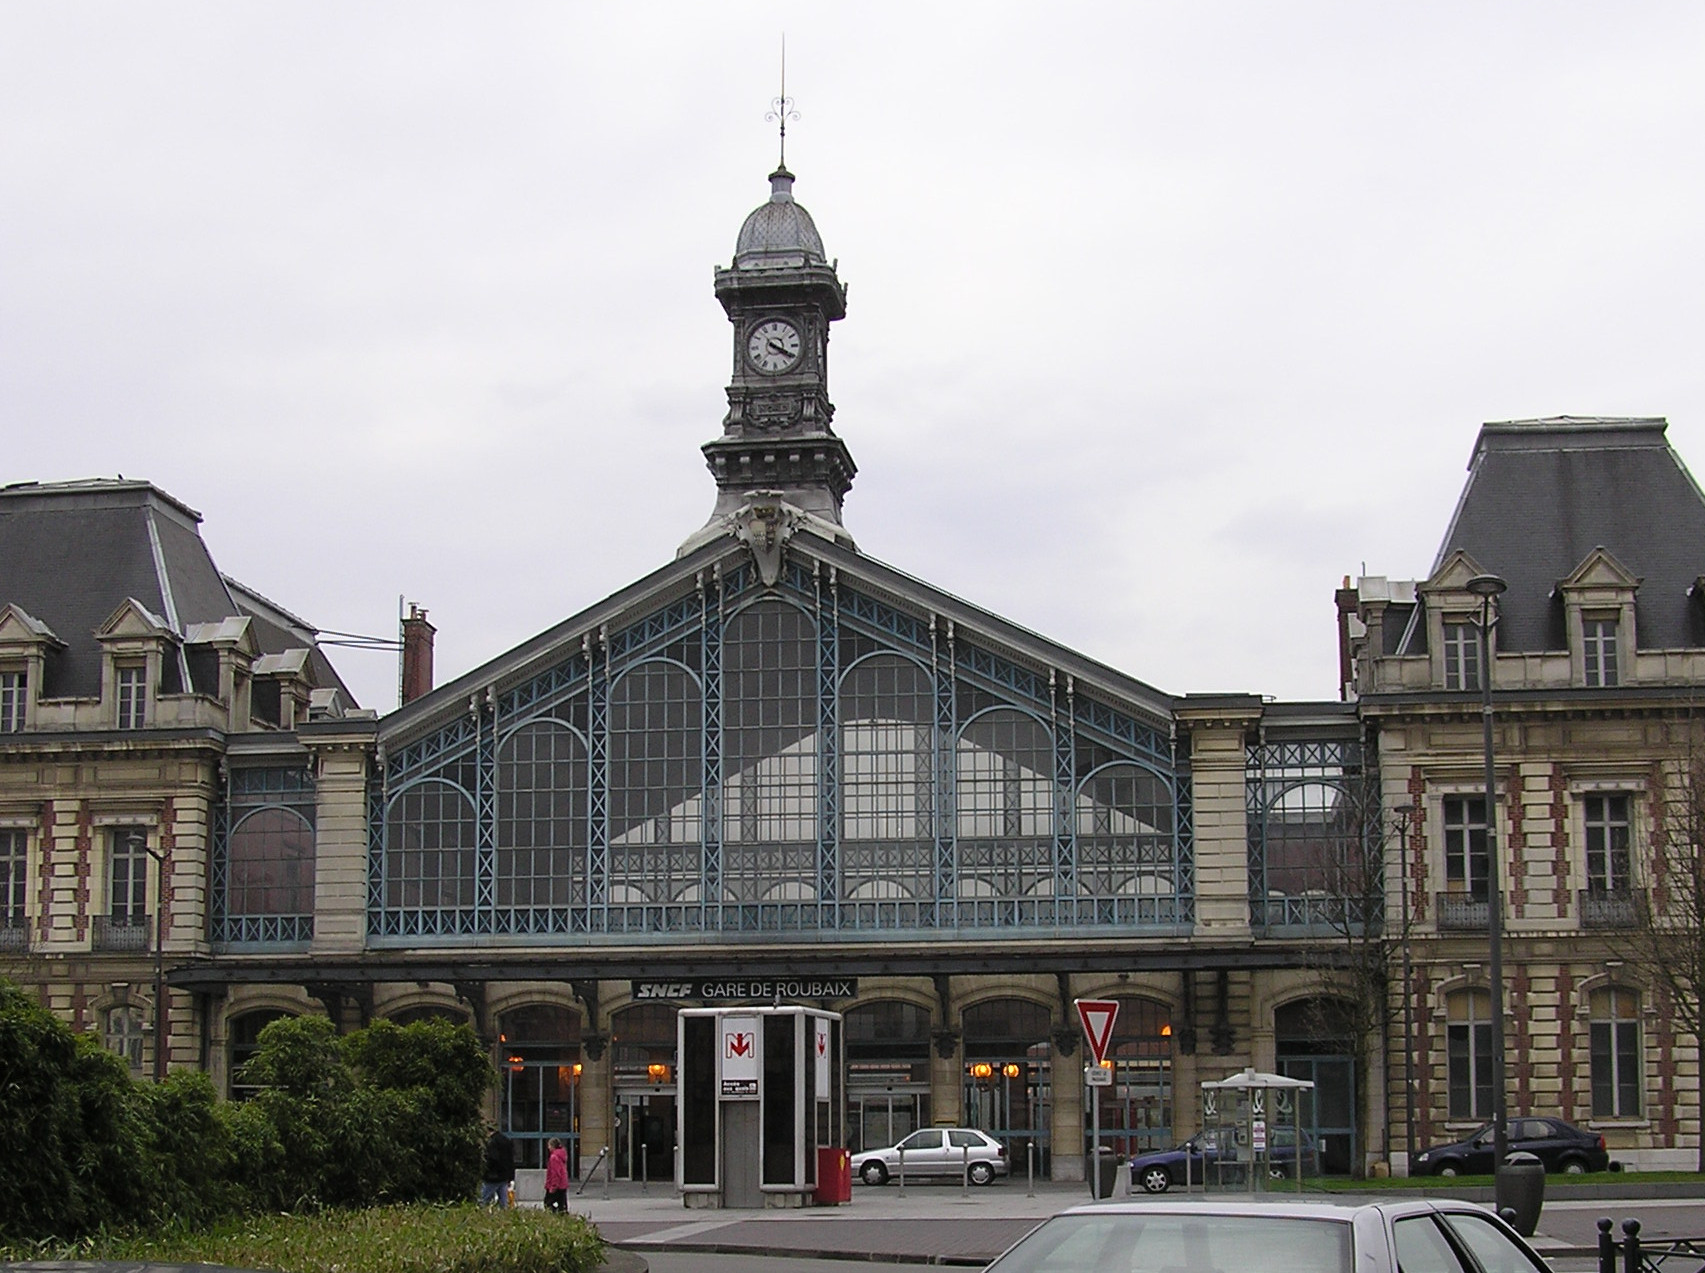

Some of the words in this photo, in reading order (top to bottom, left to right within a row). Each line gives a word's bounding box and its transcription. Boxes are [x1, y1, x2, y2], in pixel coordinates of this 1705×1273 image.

[637, 983, 693, 998] SNCF
[701, 982, 746, 998] GARE
[750, 982, 772, 997] DE
[776, 982, 851, 997] ROUBAIX
